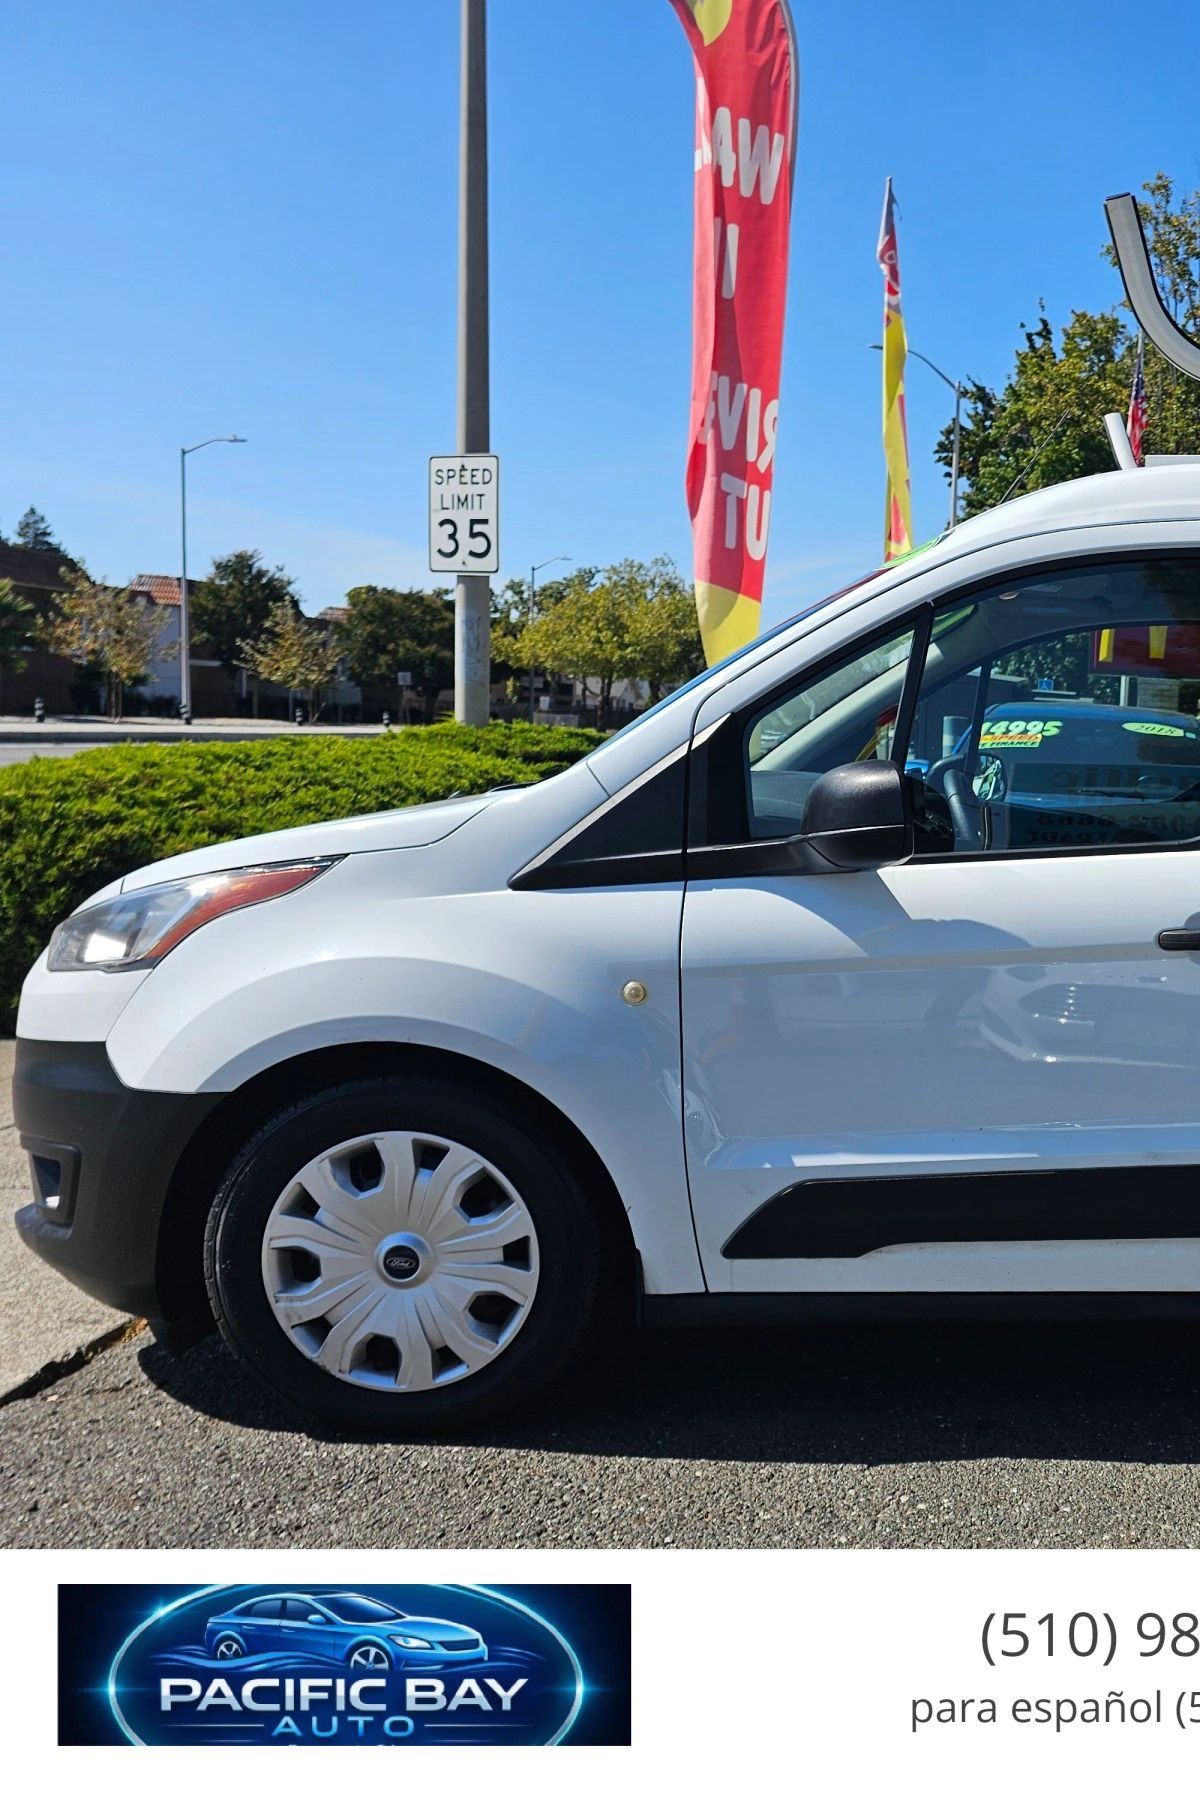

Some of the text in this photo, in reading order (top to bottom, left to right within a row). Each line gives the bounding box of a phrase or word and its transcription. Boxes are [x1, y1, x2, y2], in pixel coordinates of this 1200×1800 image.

[435, 468, 493, 485] SPEED
[440, 494, 486, 510] LIMIT
[437, 518, 491, 558] 35
[981, 734, 1039, 742] -SPEED
[1136, 725, 1176, 735] 2018
